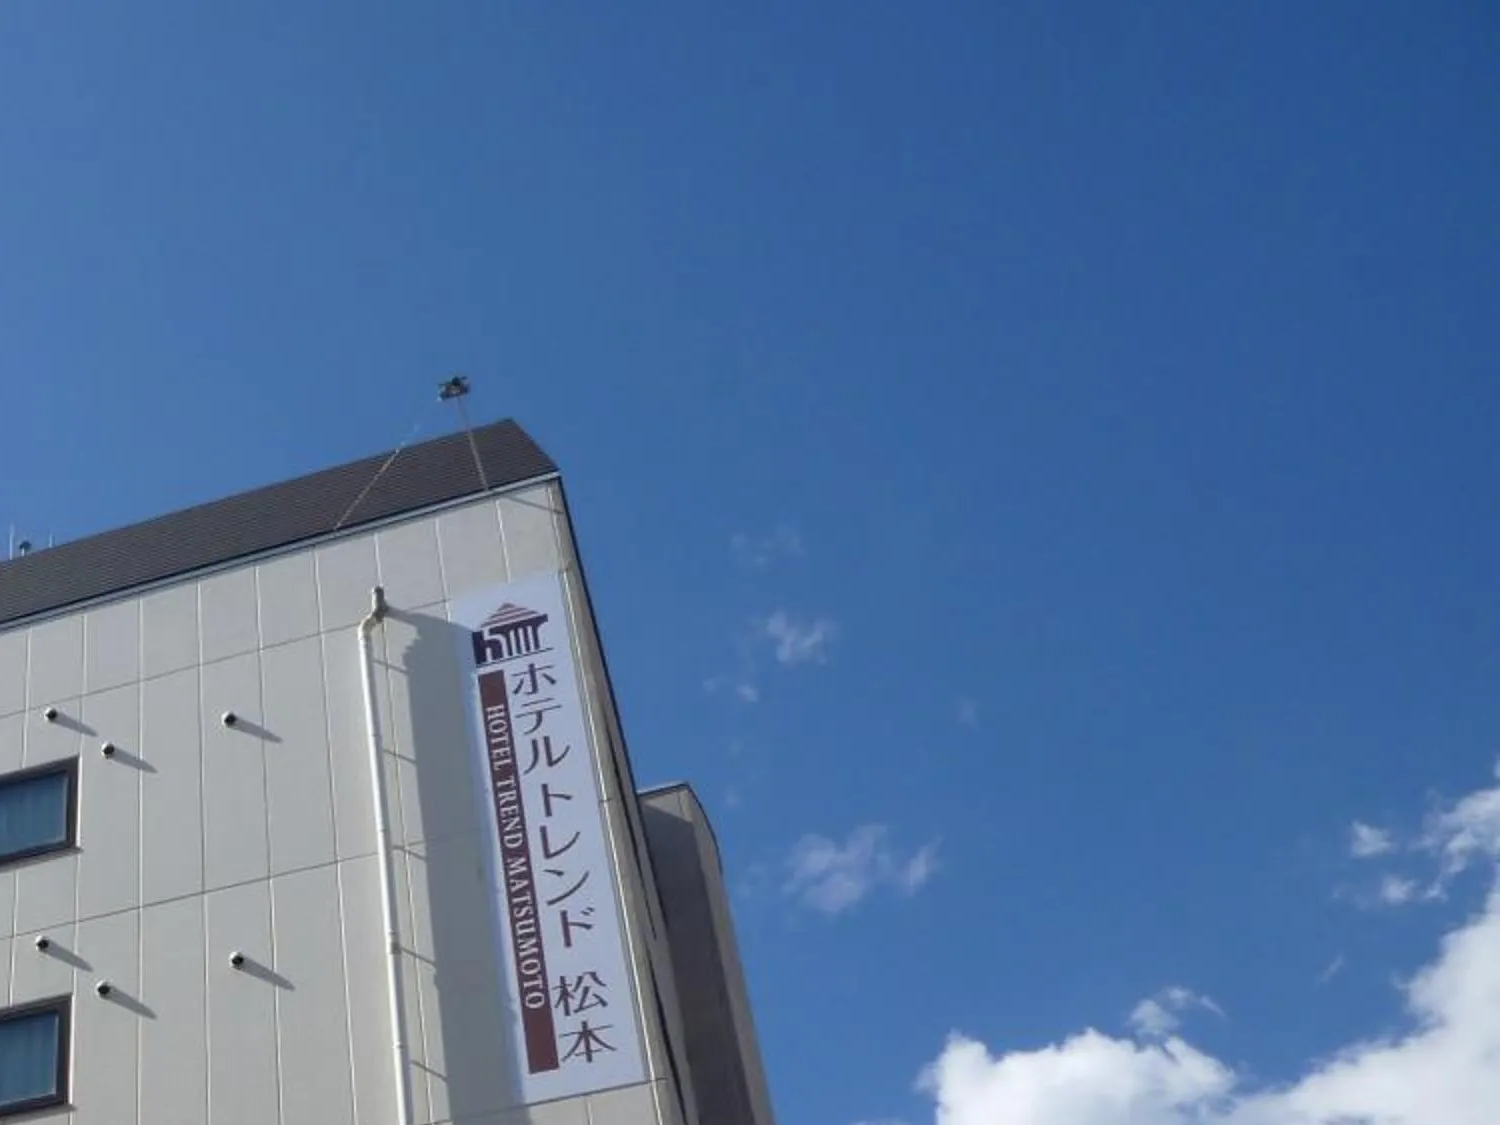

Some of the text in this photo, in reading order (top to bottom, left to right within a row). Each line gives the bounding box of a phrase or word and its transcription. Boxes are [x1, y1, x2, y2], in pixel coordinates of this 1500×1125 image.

[486, 704, 545, 1010] HOTEL TREND MATSUMOTO
[511, 663, 618, 1064] ホテルトレンド 松本
